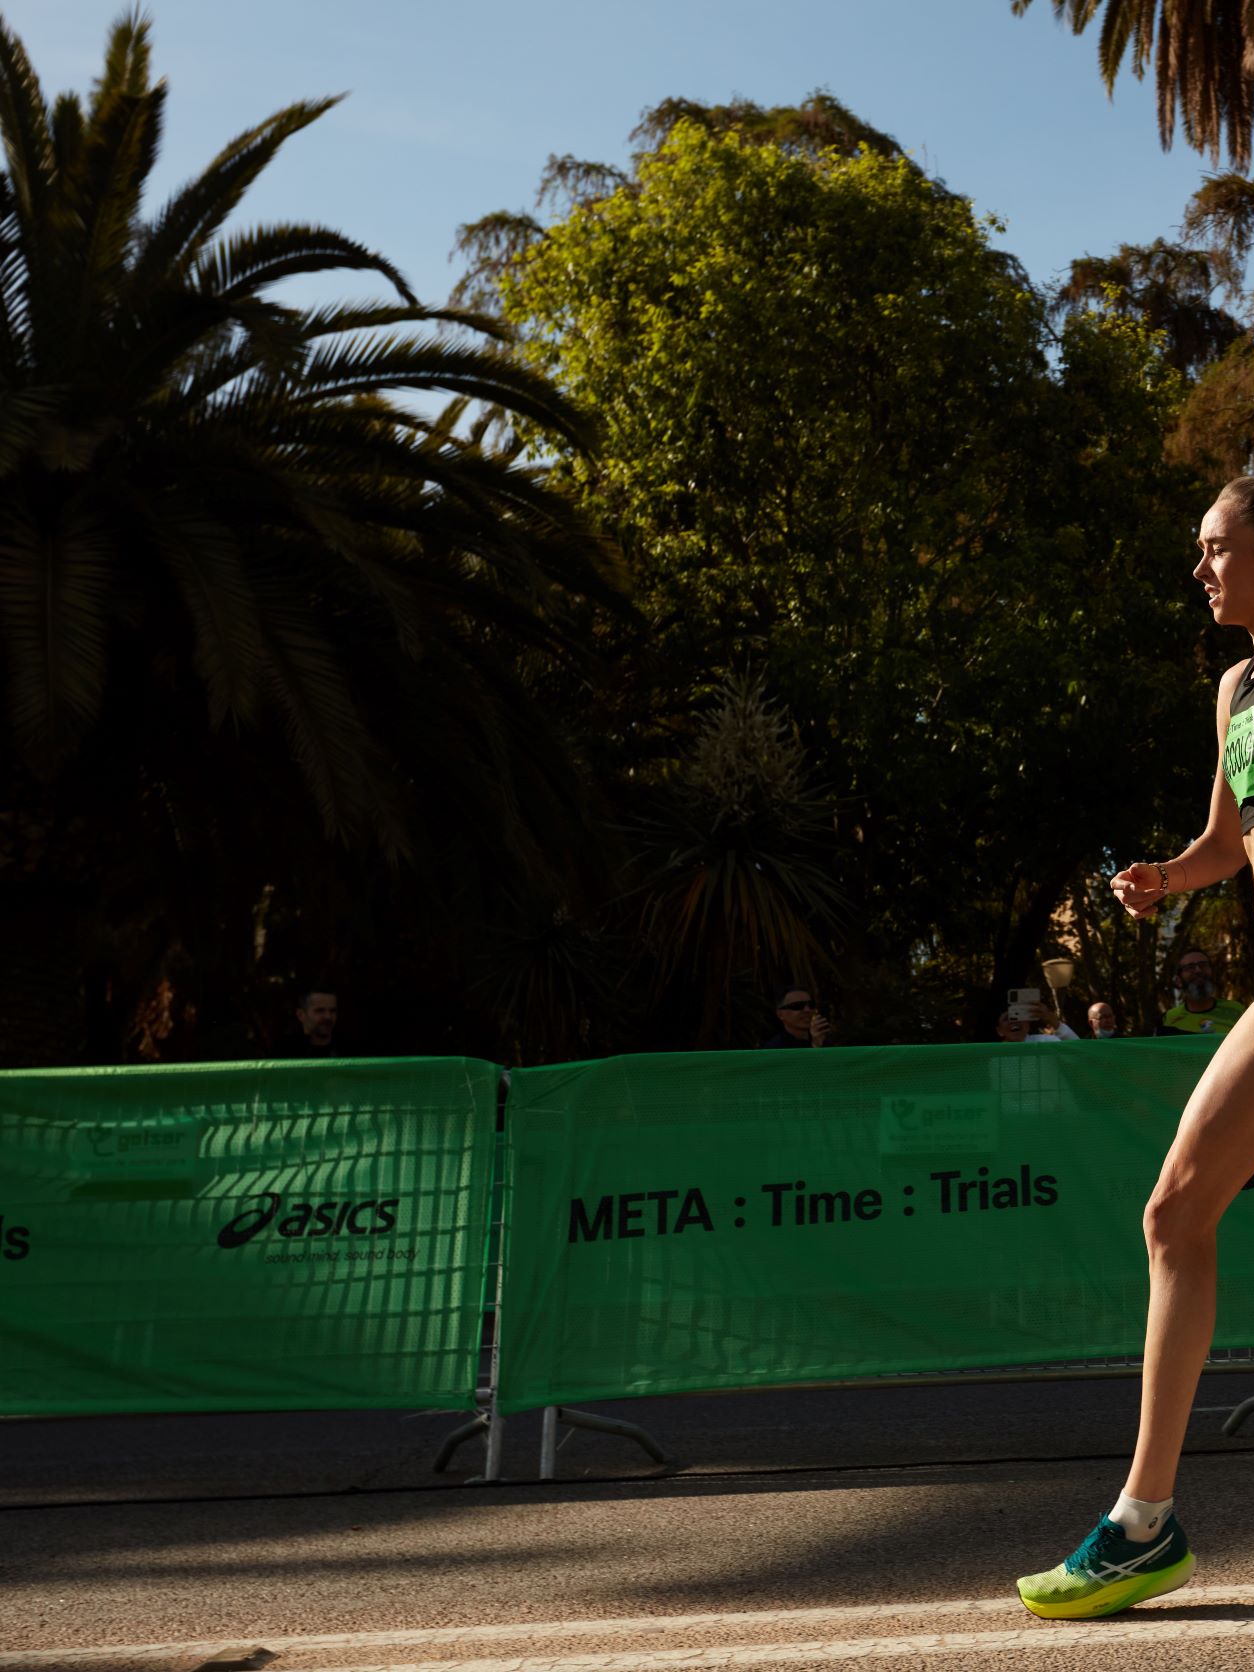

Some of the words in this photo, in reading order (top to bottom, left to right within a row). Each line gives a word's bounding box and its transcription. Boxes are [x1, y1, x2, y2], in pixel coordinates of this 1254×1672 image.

[278, 1199, 400, 1237] asics
[568, 1188, 714, 1243] META
[734, 1196, 747, 1228] :
[761, 1180, 883, 1226] Time
[903, 1185, 915, 1216] :
[930, 1164, 1058, 1213] Trials
[265, 1250, 307, 1264] sound
[344, 1247, 386, 1261] sound
